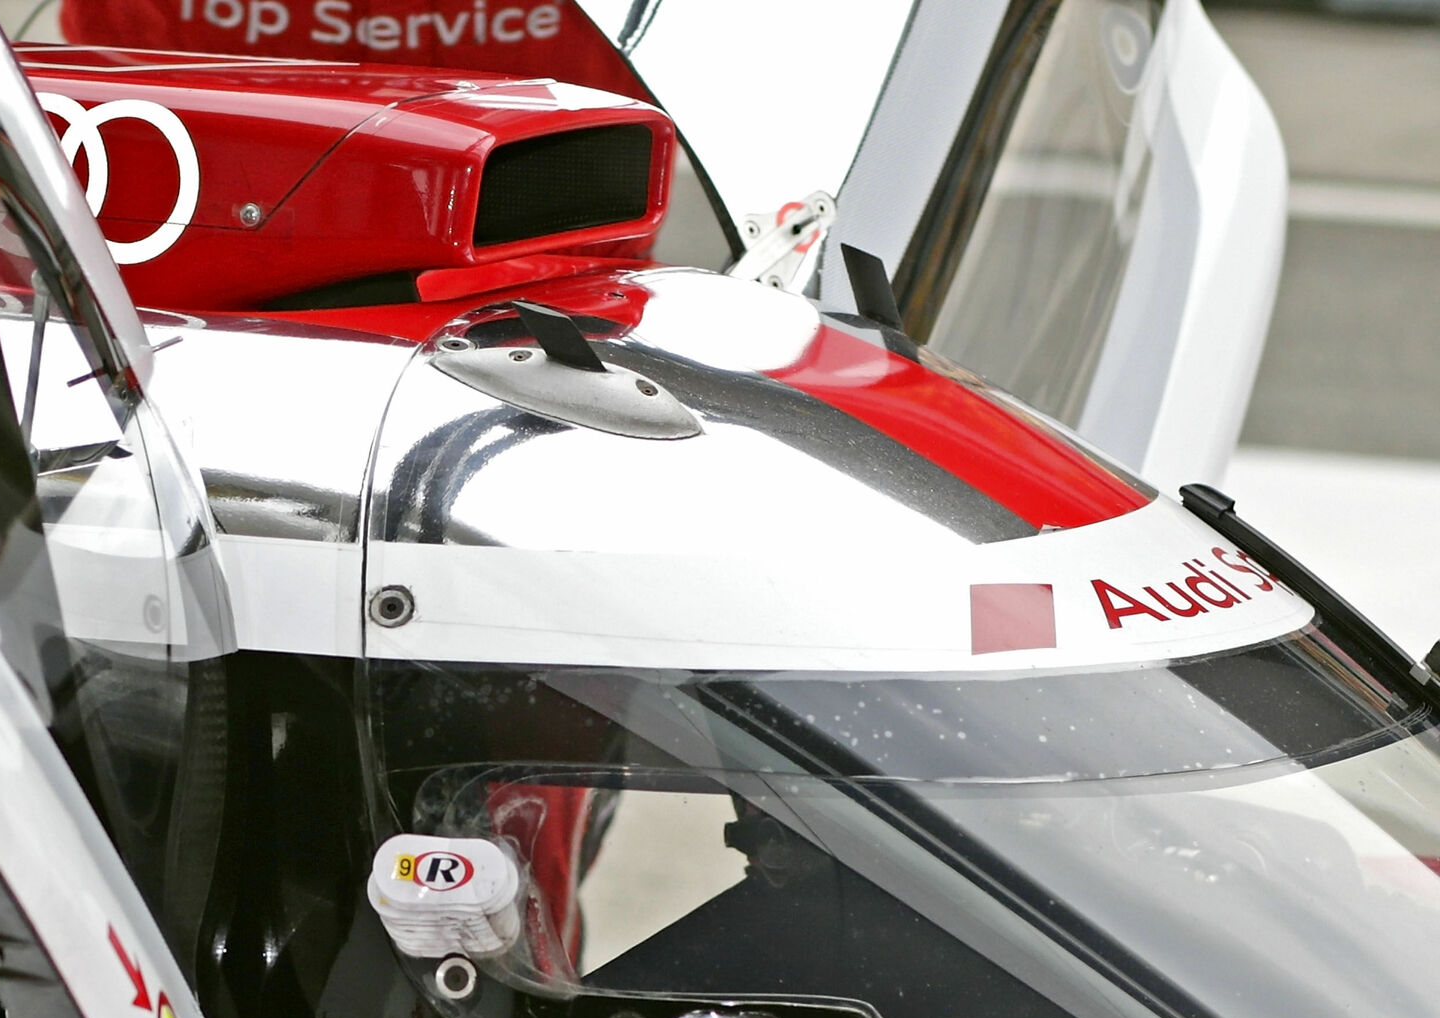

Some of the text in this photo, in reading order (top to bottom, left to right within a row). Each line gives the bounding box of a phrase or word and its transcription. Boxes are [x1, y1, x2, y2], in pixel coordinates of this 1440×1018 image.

[311, 0, 561, 51] Service
[1090, 557, 1252, 630] Audi
[399, 857, 460, 883] 9 R
